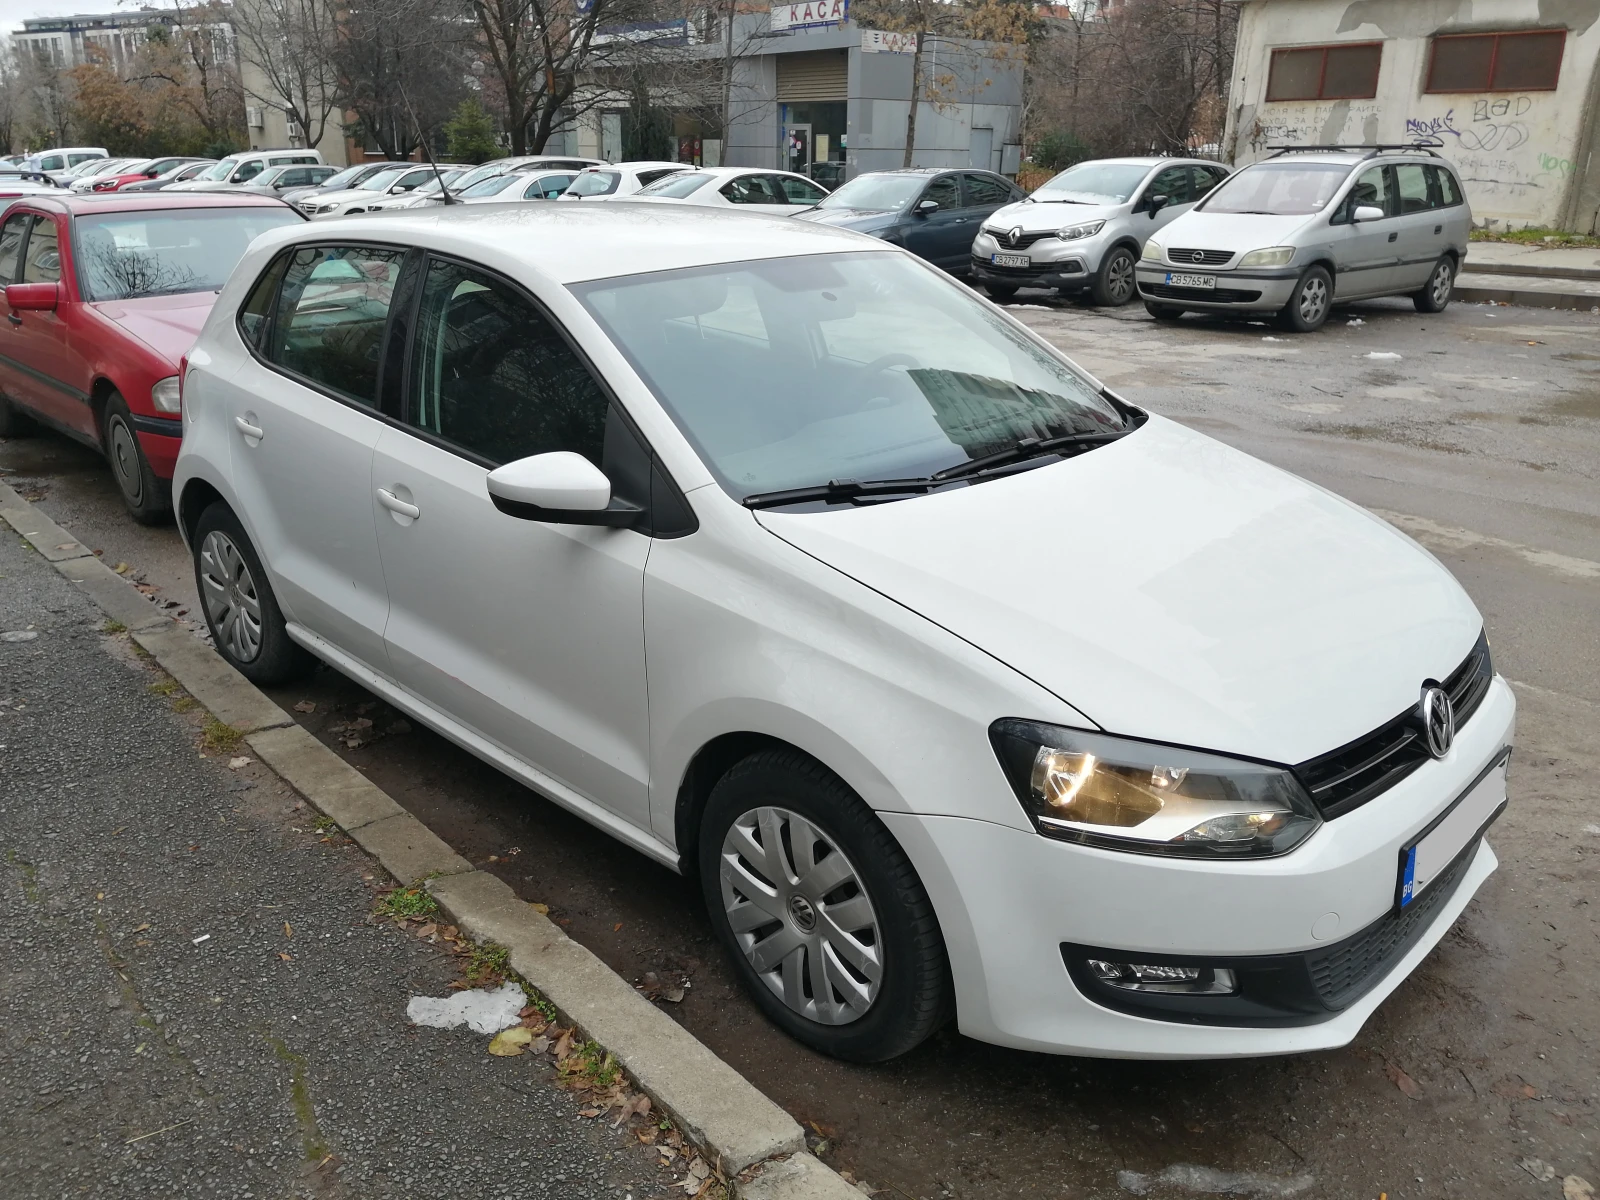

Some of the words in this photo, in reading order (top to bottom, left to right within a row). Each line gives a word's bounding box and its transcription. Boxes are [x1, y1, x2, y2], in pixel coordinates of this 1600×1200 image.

[790, 0, 841, 22] КАСА
[882, 33, 917, 47] КАСА
[1004, 256, 1018, 265] 2797
[1019, 257, 1029, 266] XH
[1170, 274, 1182, 285] CB
[1182, 275, 1202, 287] 5765
[1402, 880, 1413, 898] BG
